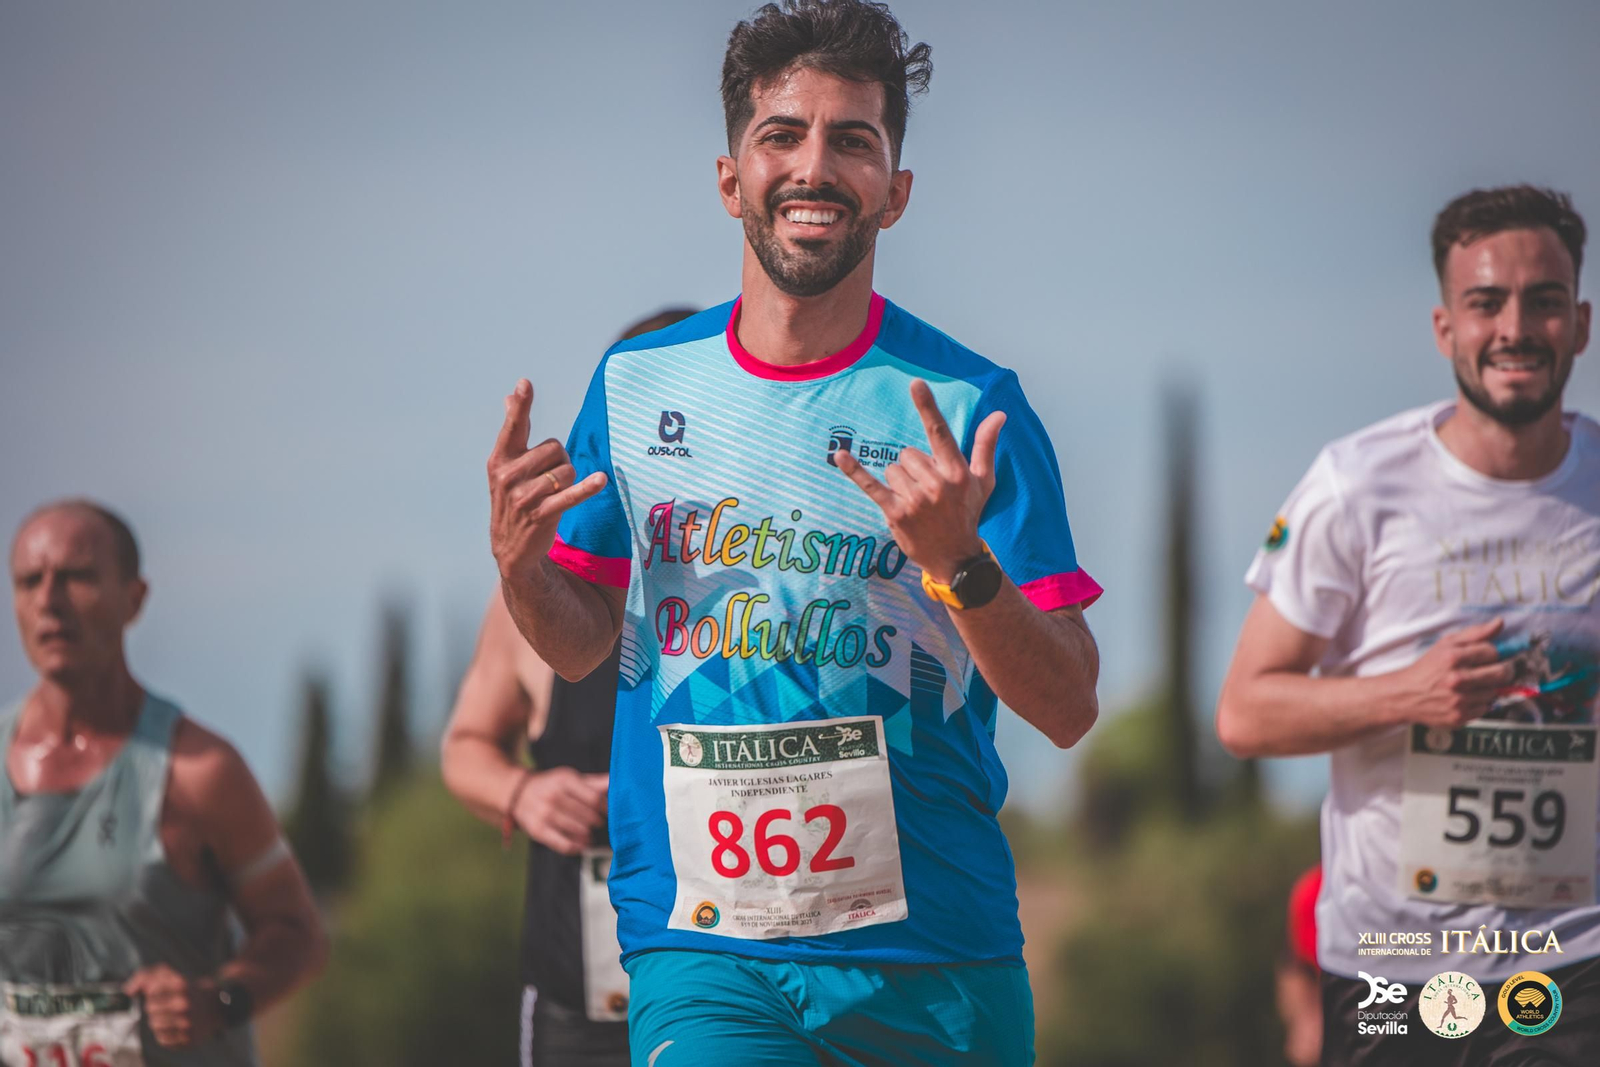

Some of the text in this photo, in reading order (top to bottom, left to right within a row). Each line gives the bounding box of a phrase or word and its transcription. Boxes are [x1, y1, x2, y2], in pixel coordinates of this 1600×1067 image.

[648, 446, 692, 458] austral
[859, 445, 899, 461] Bollu
[872, 460, 886, 468] del
[644, 497, 908, 580] Atletismo
[655, 592, 897, 668] Bollullos
[713, 734, 820, 763] ITÁLICA
[708, 771, 833, 787] JAVIER IGLESIAS LAGARES
[731, 785, 809, 797] INDEPENDIENTE
[1444, 786, 1568, 850] 559
[708, 804, 855, 879] 862
